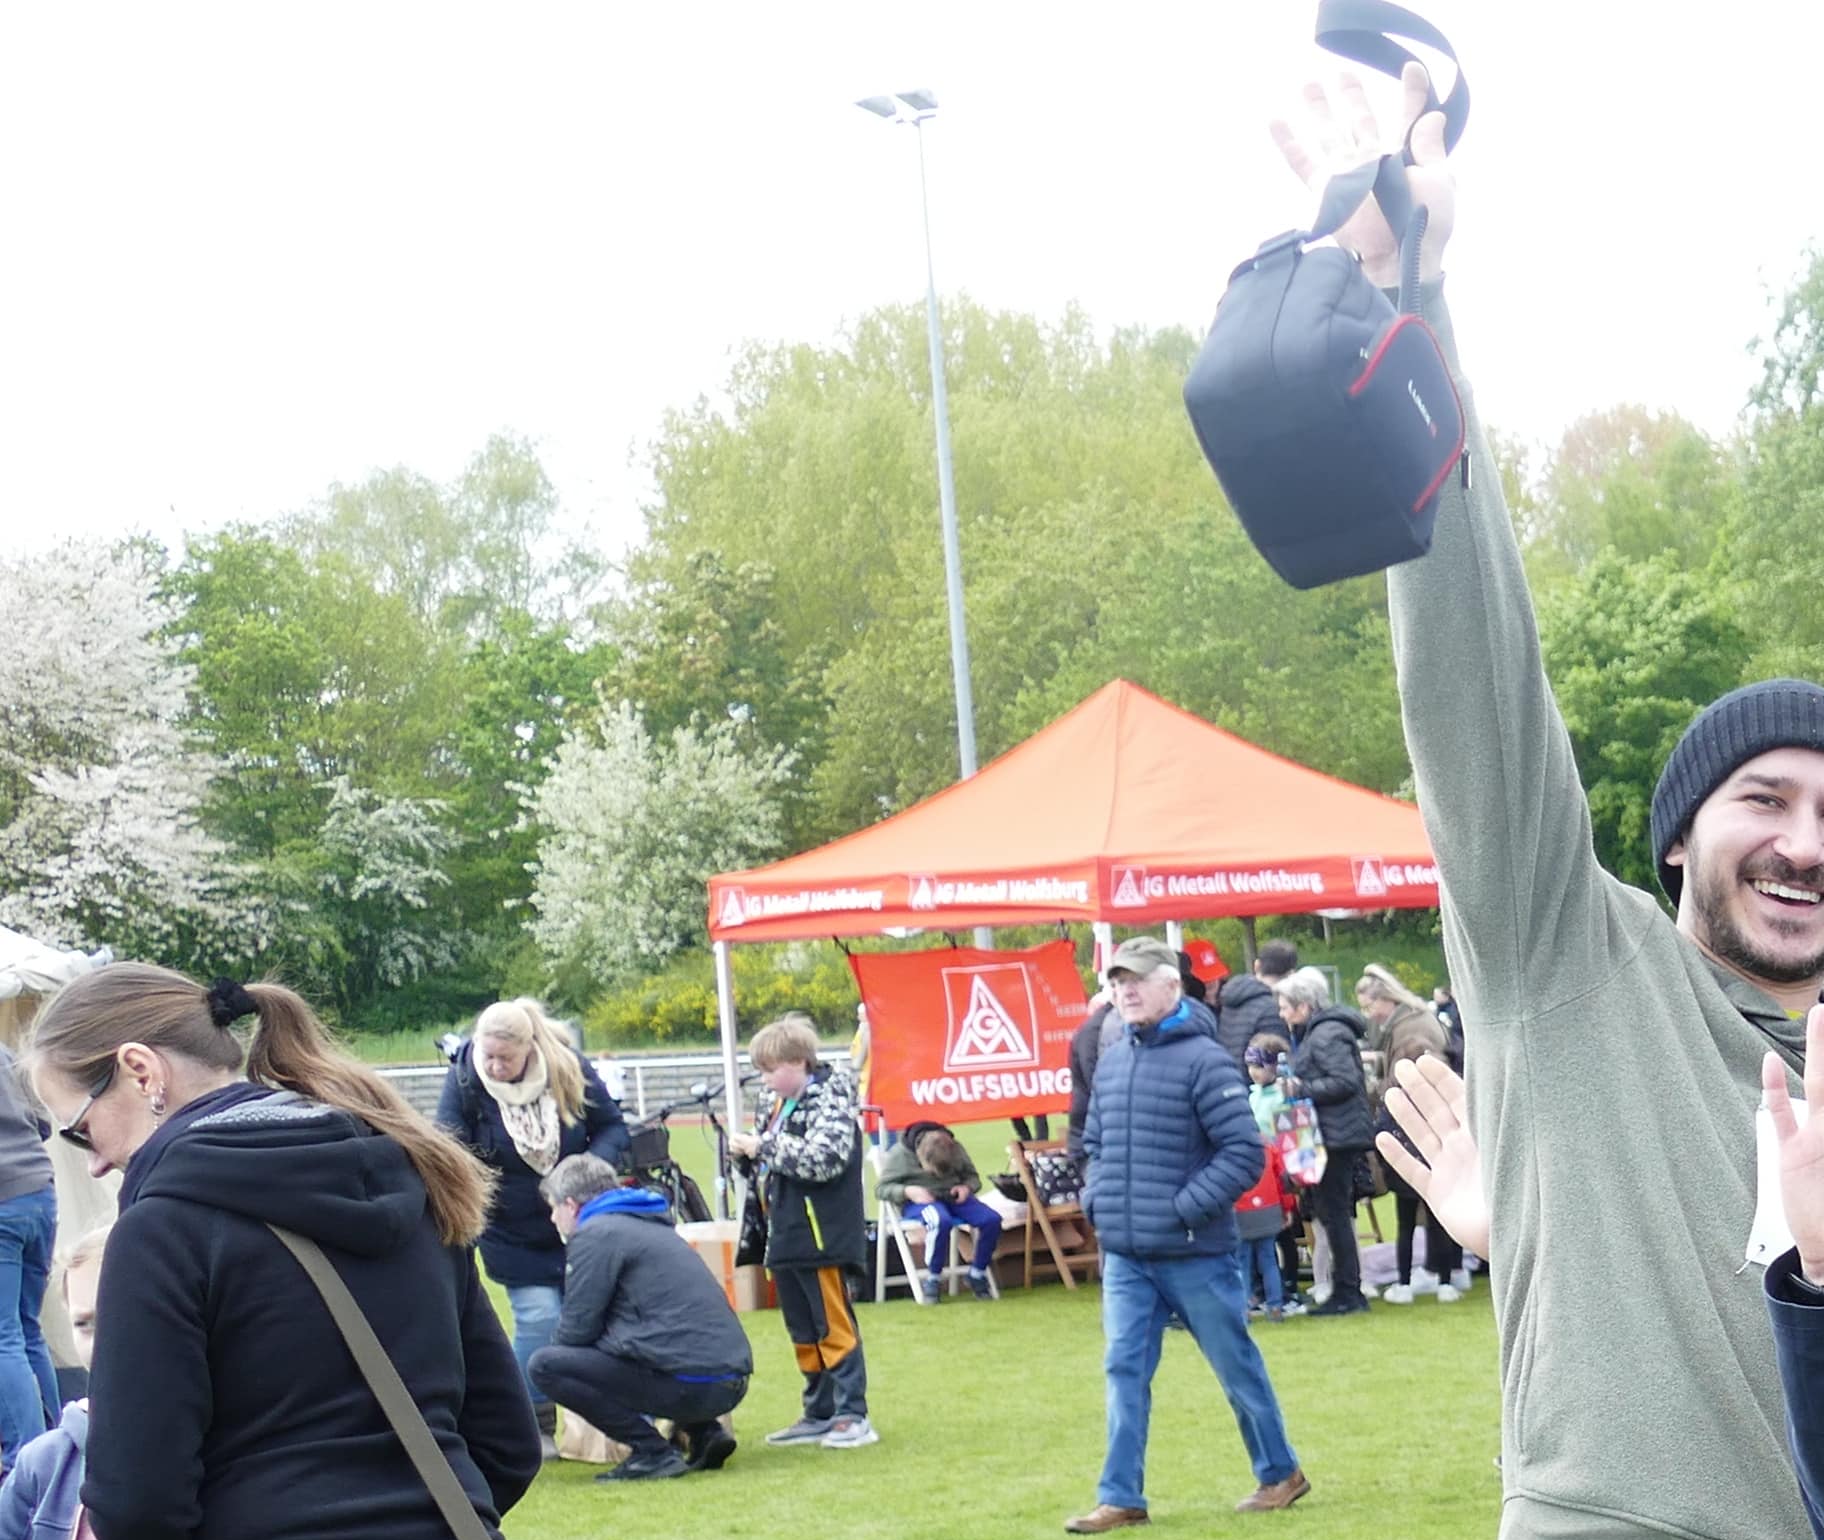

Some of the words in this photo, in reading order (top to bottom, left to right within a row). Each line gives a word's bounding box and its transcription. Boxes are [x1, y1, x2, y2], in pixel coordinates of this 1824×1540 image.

[1144, 875, 1163, 897] IG
[1167, 871, 1228, 896] Metall
[1228, 868, 1324, 894] Wolfsburg
[1383, 866, 1402, 885] IG
[1403, 864, 1440, 884] Met
[911, 1067, 1073, 1105] WOLFSBURG
